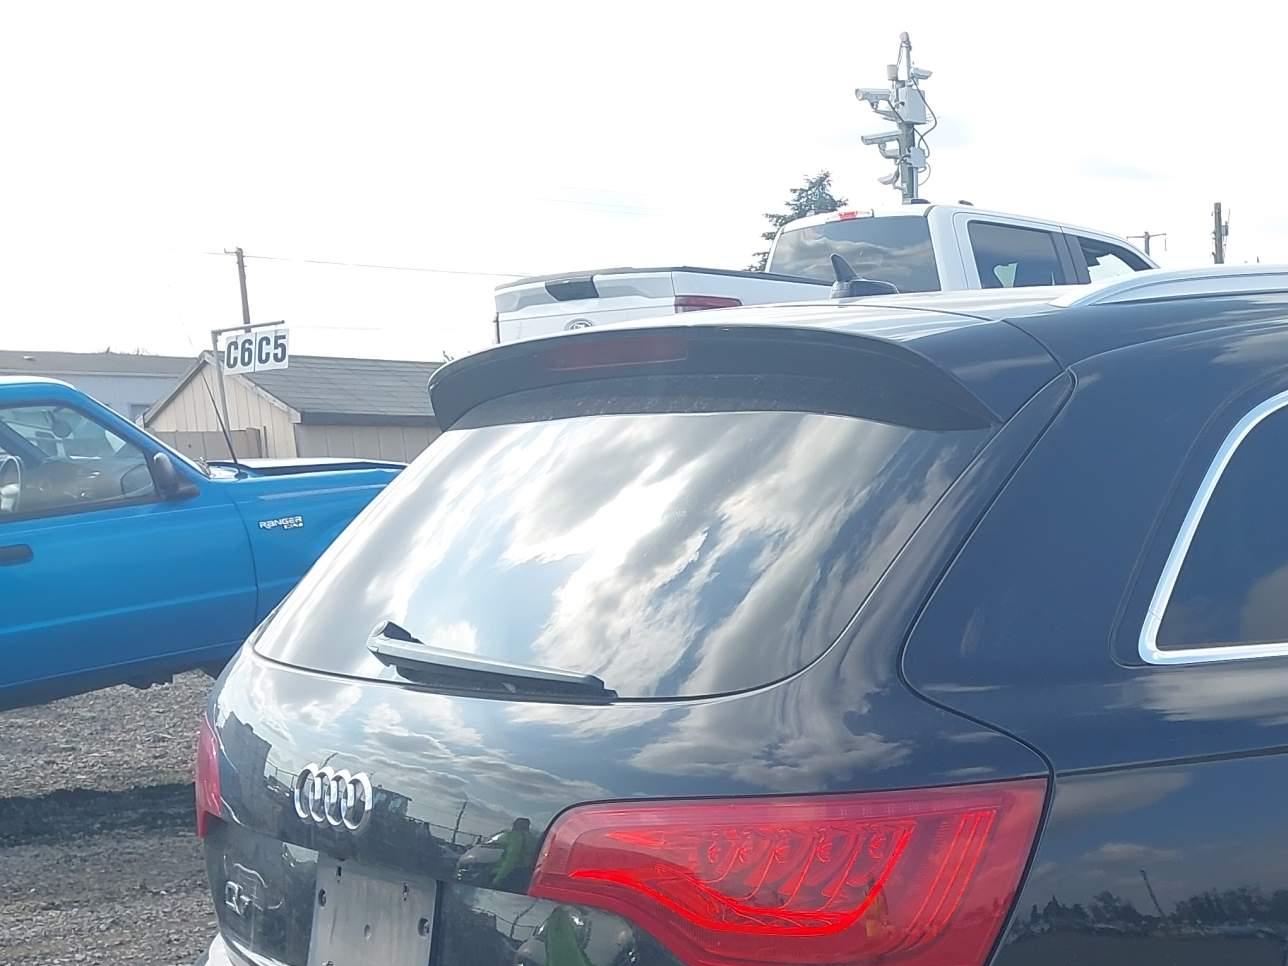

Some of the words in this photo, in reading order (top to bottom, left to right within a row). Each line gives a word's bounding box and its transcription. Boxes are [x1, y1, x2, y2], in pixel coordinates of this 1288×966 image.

[226, 339, 254, 369] C6
[257, 334, 287, 365] C5
[258, 515, 303, 529] RANGER
